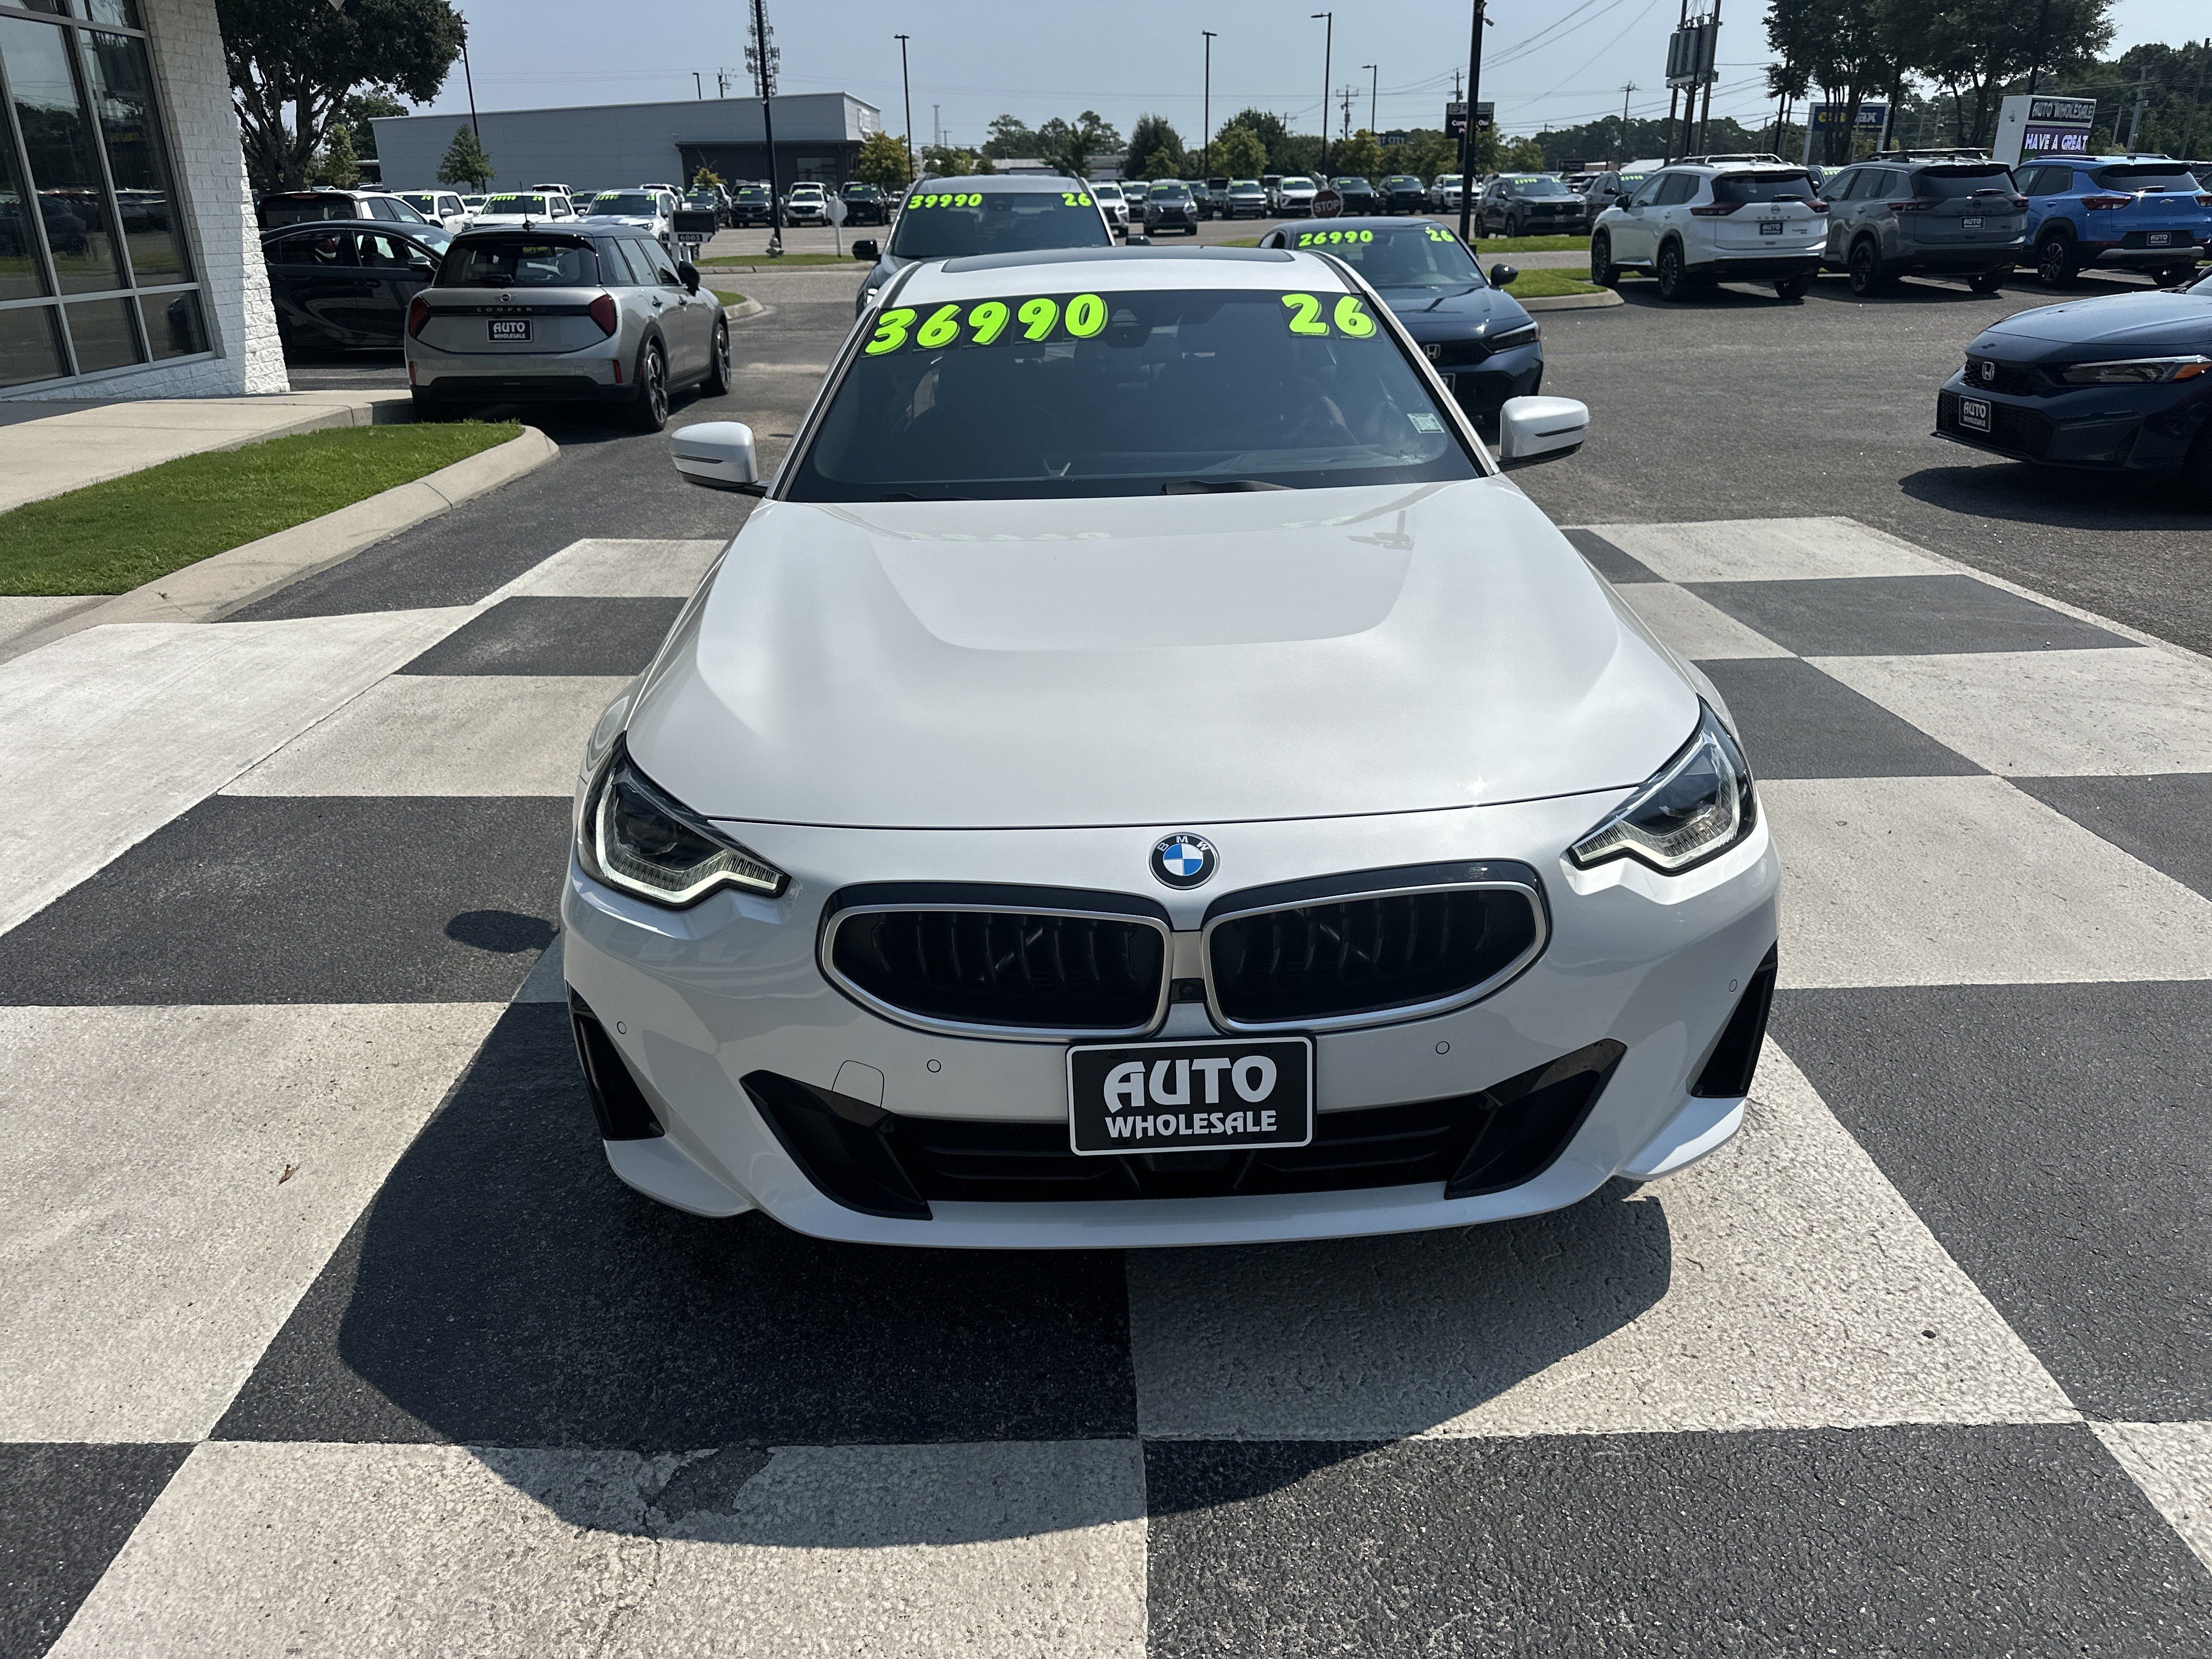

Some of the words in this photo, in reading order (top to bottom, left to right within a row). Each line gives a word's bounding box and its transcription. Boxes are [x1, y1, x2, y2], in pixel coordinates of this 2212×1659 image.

[2032, 101, 2053, 118] AUTO
[2054, 102, 2095, 120] WHOLESALE
[2024, 133, 2051, 150] HAVE
[2051, 134, 2058, 150] A
[2061, 134, 2089, 151] GREAT
[908, 193, 983, 210] 39990
[1062, 193, 1092, 207] 26
[1314, 200, 1340, 213] STOP
[1298, 230, 1374, 247] 26990
[1425, 229, 1454, 242] 26
[493, 322, 526, 333] AUTO
[865, 294, 1109, 356] 36990
[1282, 293, 1377, 338] 26
[1963, 401, 1987, 419] AUTO
[1156, 836, 1210, 852] BMW
[1103, 1055, 1277, 1114] AUTO
[1104, 1110, 1278, 1139] WHOLESALE
